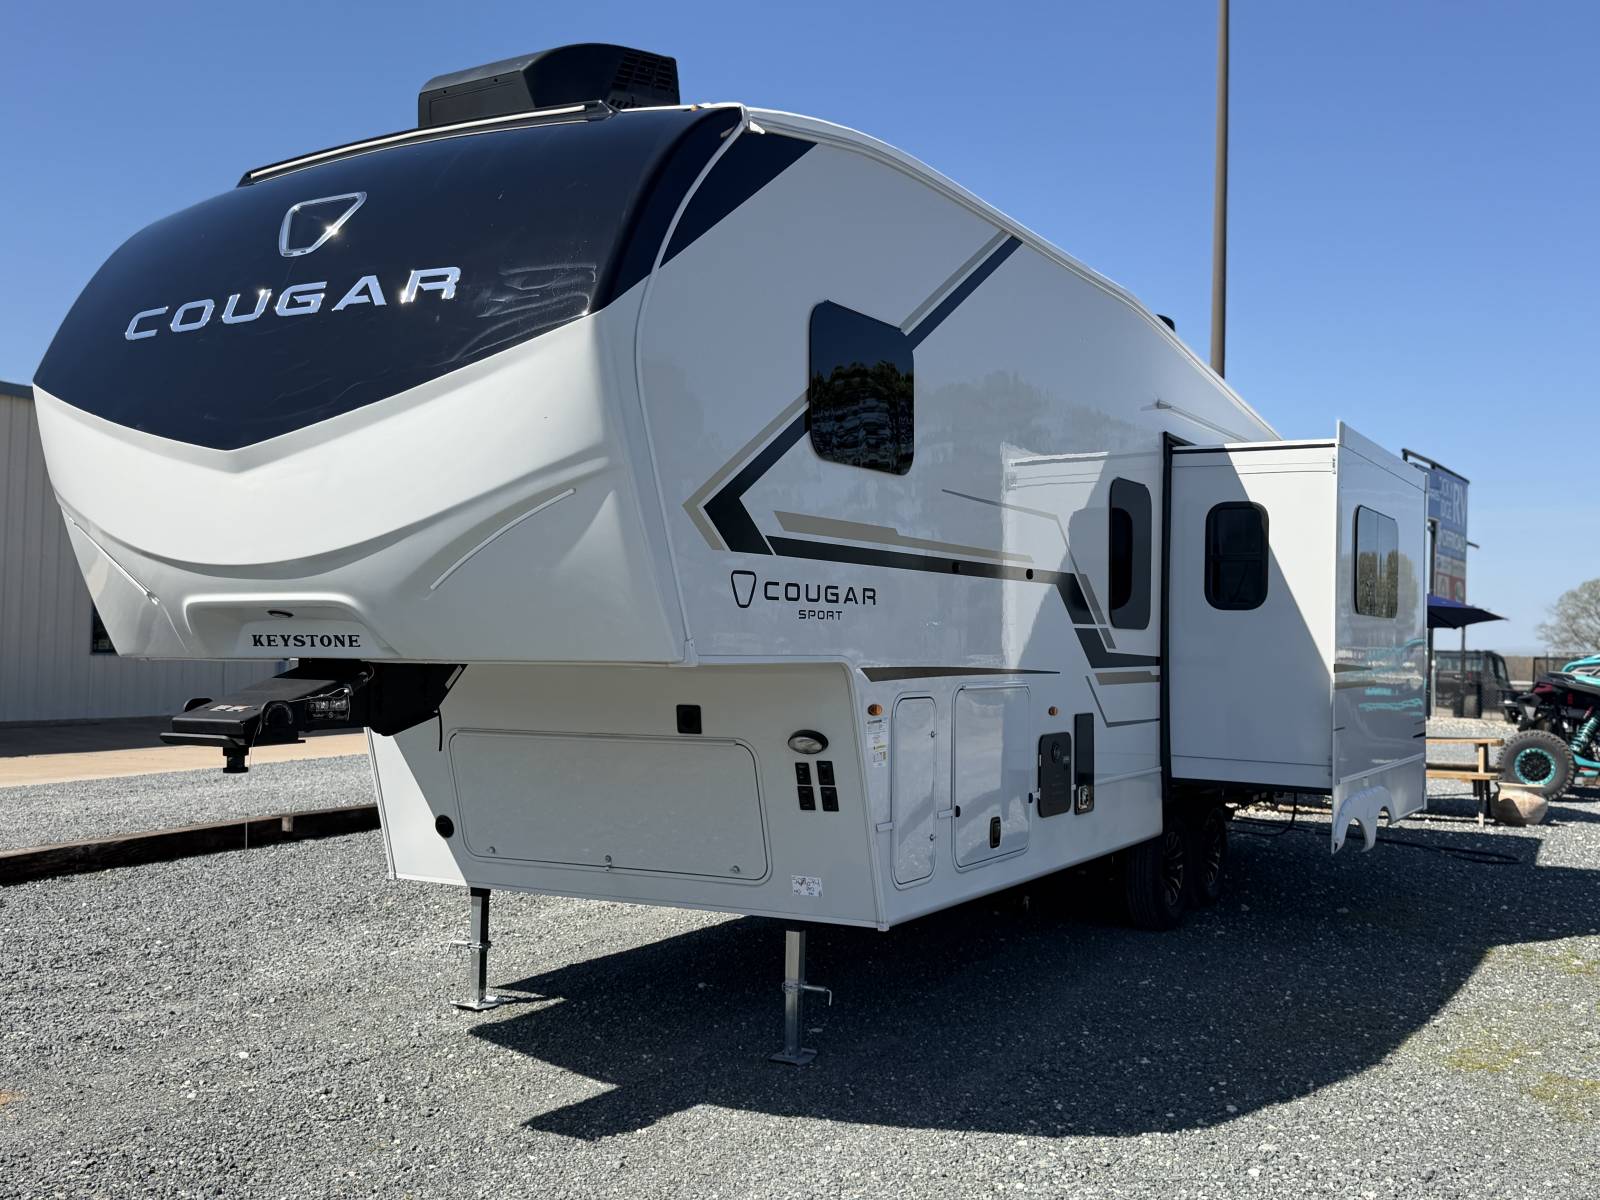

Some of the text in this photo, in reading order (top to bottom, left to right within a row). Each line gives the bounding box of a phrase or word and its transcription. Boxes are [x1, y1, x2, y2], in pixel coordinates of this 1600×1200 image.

[124, 266, 462, 341] COUGAR
[763, 581, 877, 606] COUGAR
[798, 609, 843, 621] SPORT
[252, 633, 361, 648] KEYSTONE
